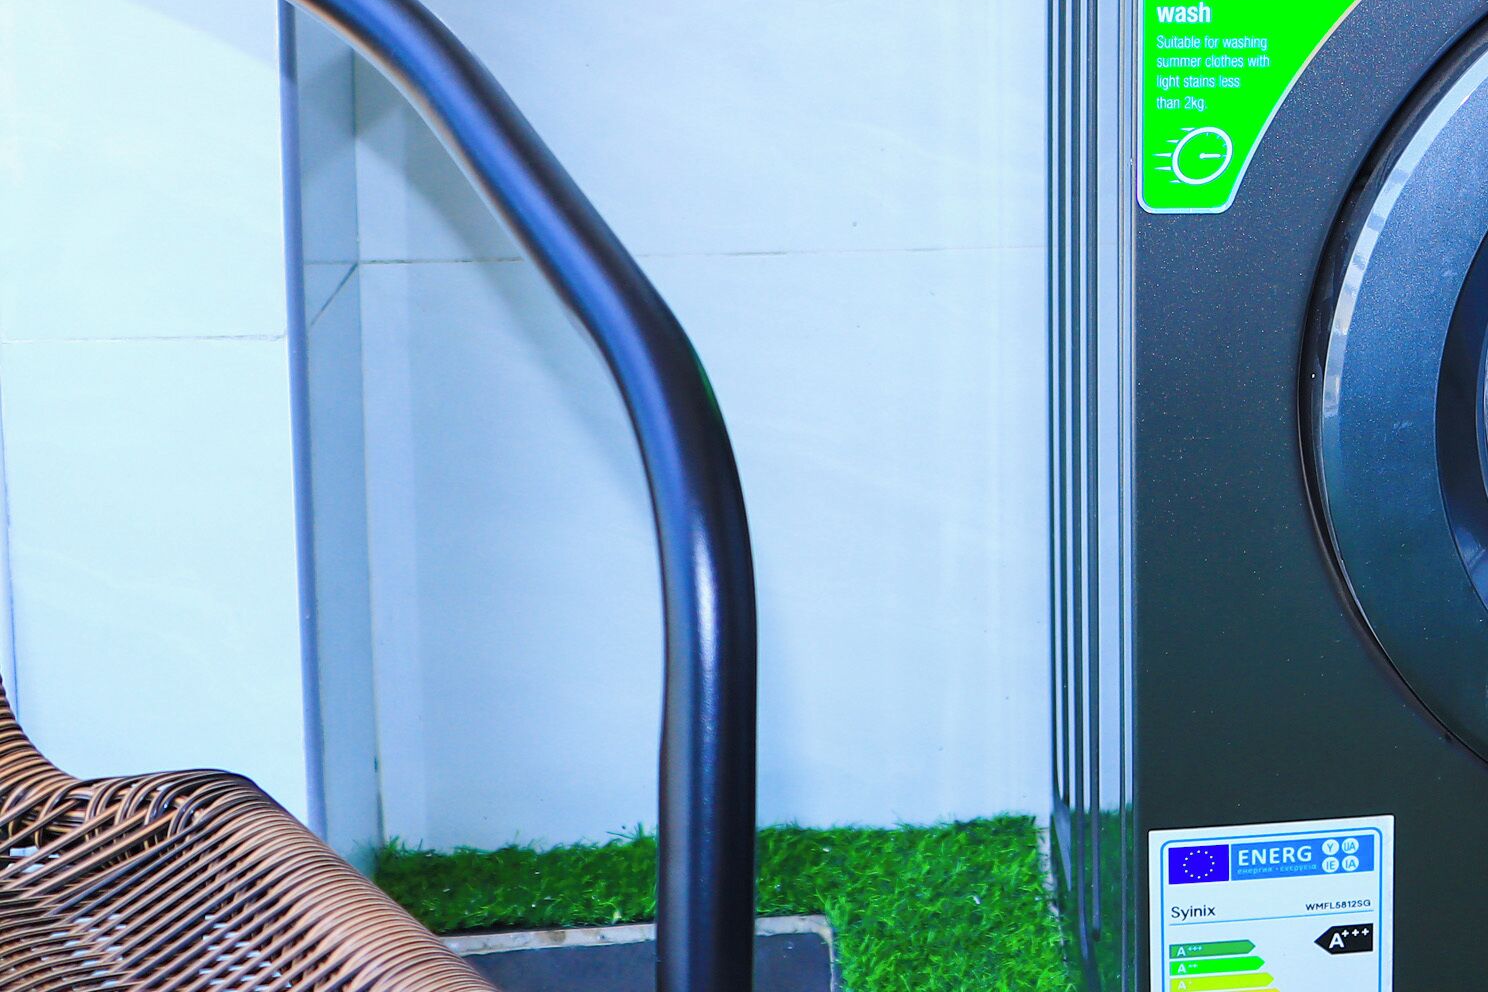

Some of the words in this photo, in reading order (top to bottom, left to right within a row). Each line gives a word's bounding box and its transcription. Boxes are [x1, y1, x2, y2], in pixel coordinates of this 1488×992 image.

[1157, 1, 1211, 23] wash
[1156, 35, 1202, 49] Suitable
[1204, 35, 1219, 49] for
[1222, 35, 1268, 51] washing
[1156, 56, 1202, 68] summer
[1205, 54, 1244, 68] clothes
[1247, 54, 1270, 68] with
[1156, 75, 1180, 91] light
[1183, 75, 1216, 88] stains
[1218, 75, 1241, 88] less
[1156, 96, 1182, 109] than
[1184, 96, 1208, 112] 2kg.
[1327, 843, 1335, 852] Y
[1238, 845, 1312, 867] ENERG
[1326, 860, 1335, 870] IE
[1170, 904, 1216, 922] Syinix
[1305, 899, 1371, 912] WMFL5812SG
[1329, 927, 1370, 949] A+++
